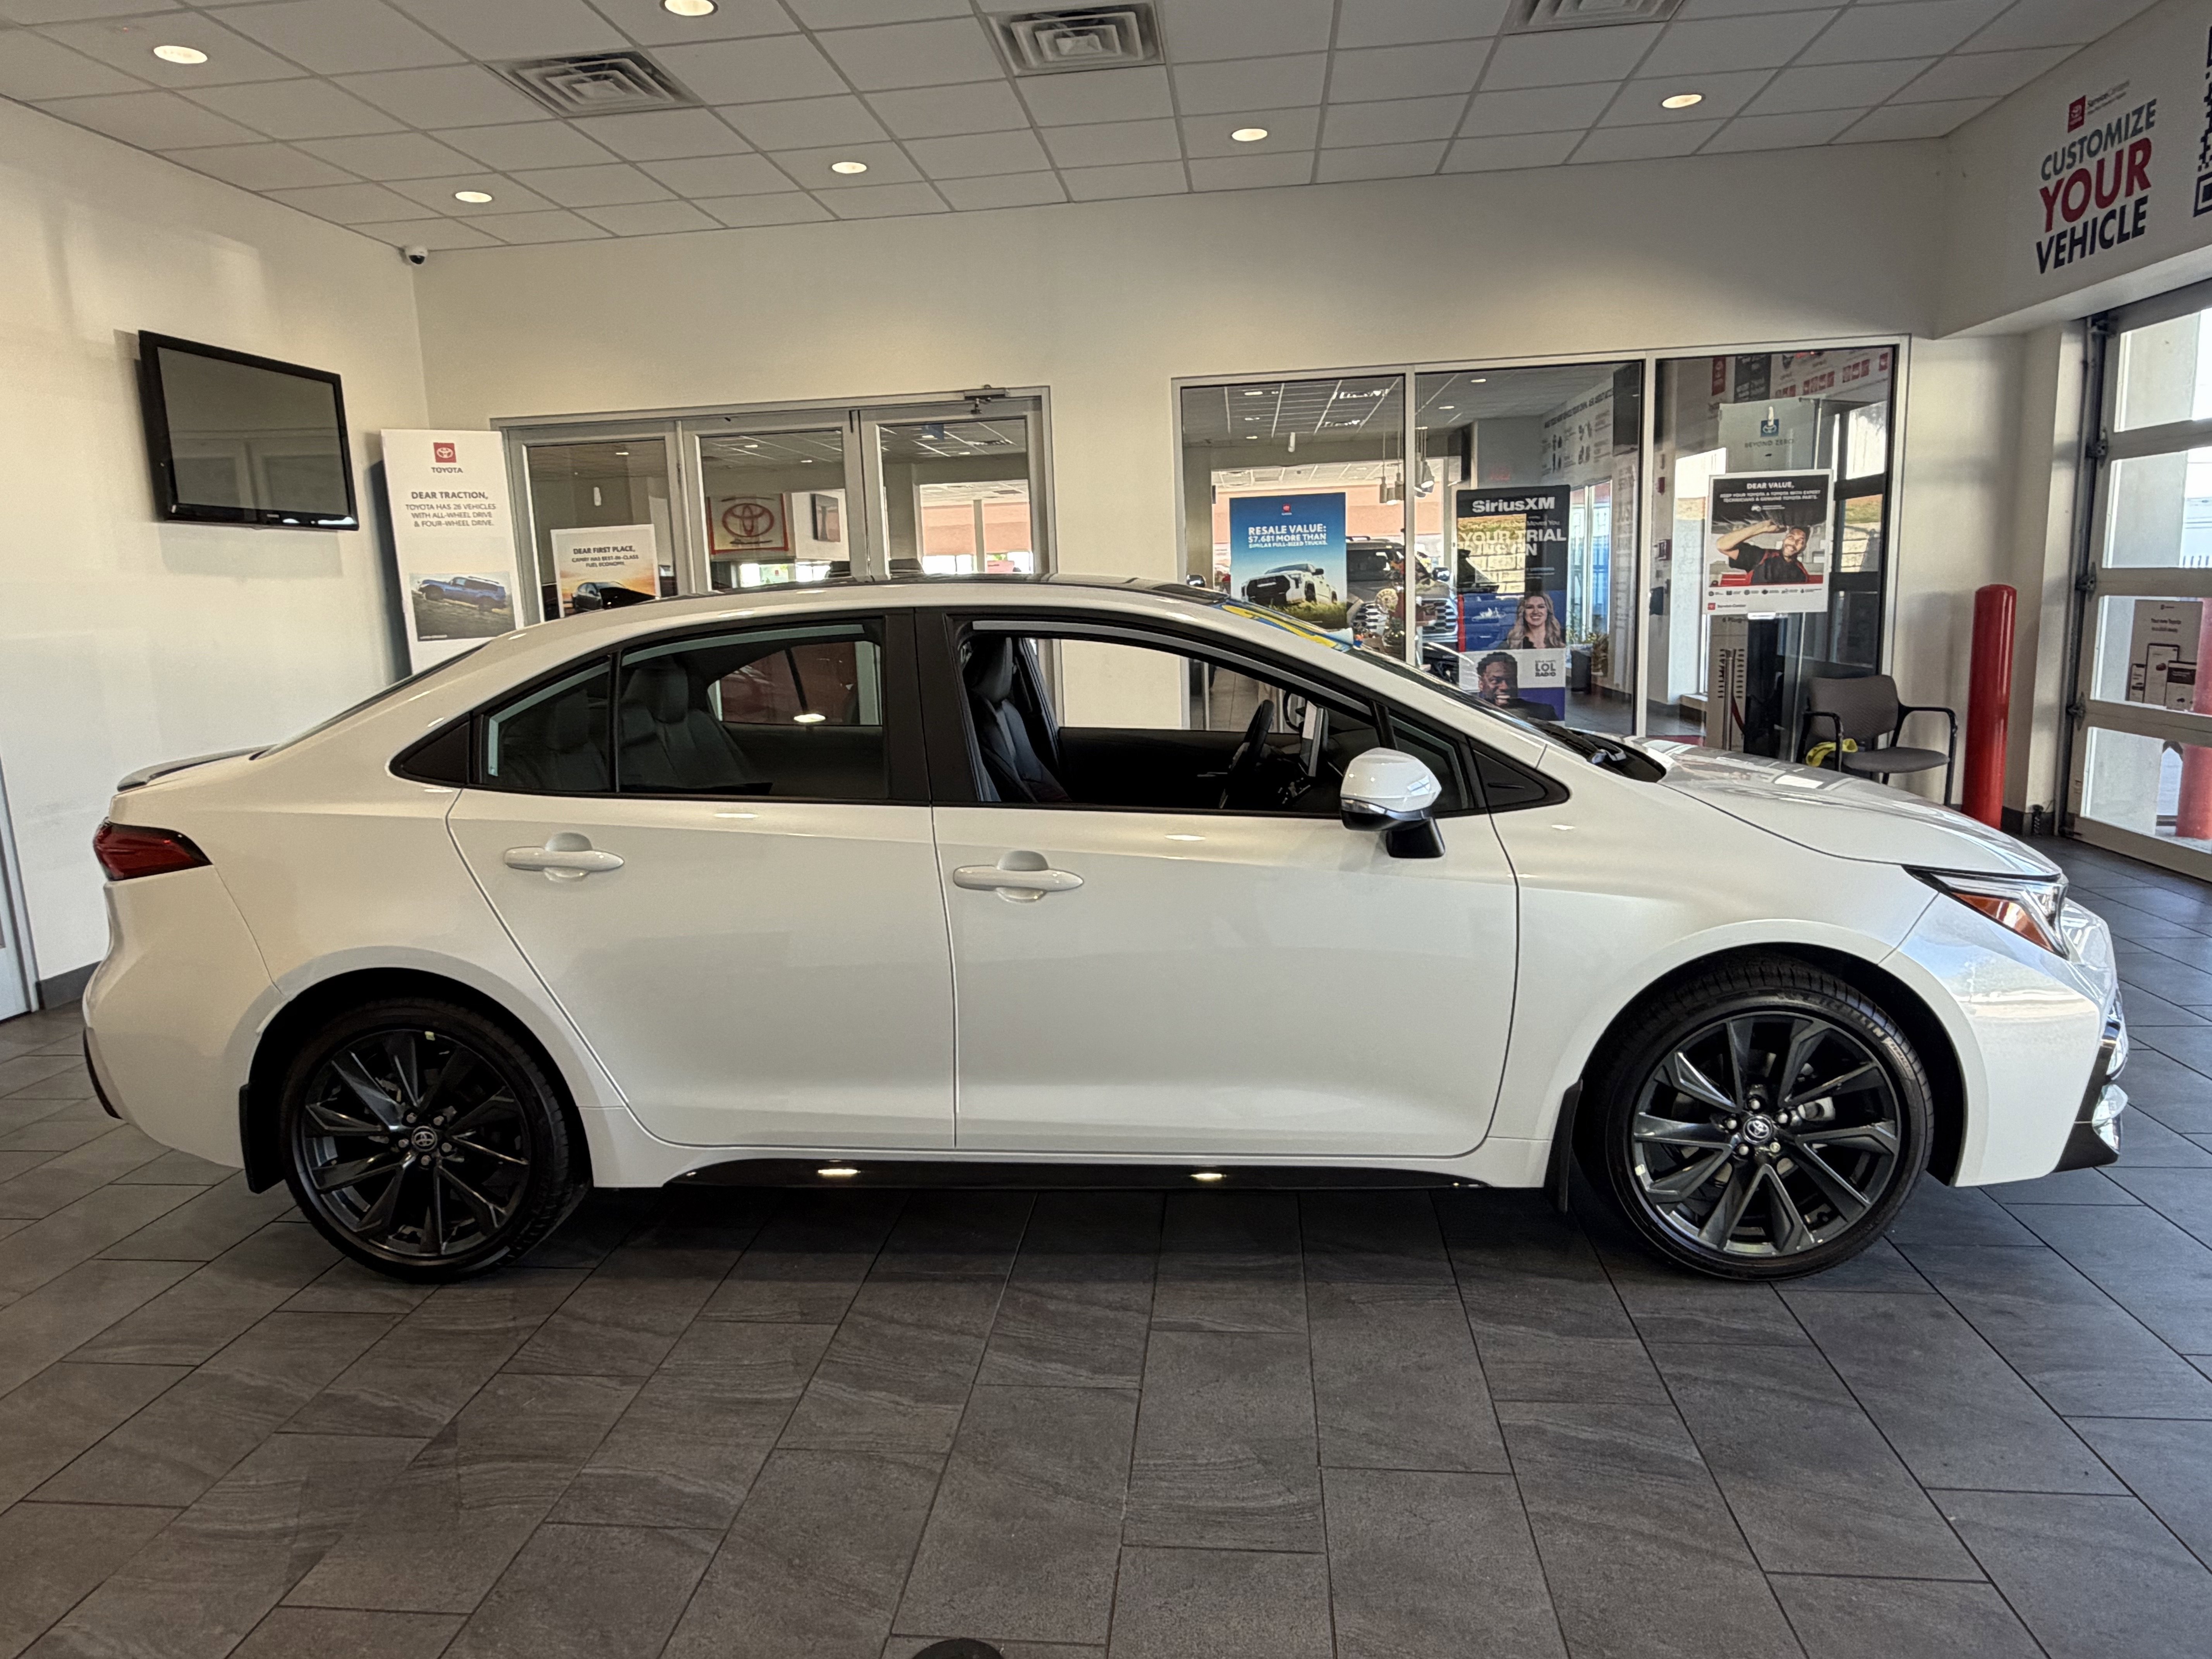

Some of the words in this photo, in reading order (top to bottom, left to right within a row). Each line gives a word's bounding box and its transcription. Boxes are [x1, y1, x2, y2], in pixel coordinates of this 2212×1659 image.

[2041, 98, 2157, 181] CUSTOMIZE
[2039, 137, 2152, 233] YOUR
[2036, 195, 2148, 274] VEHICLE
[439, 491, 488, 500] TRACTION,
[1472, 496, 1555, 513] SiriusXM
[1248, 526, 1287, 535] RESALE
[1289, 523, 1327, 534] VALUE:
[1462, 531, 1511, 544] YOUR
[1514, 528, 1567, 541] TRIAL
[1535, 663, 1556, 672] LOL
